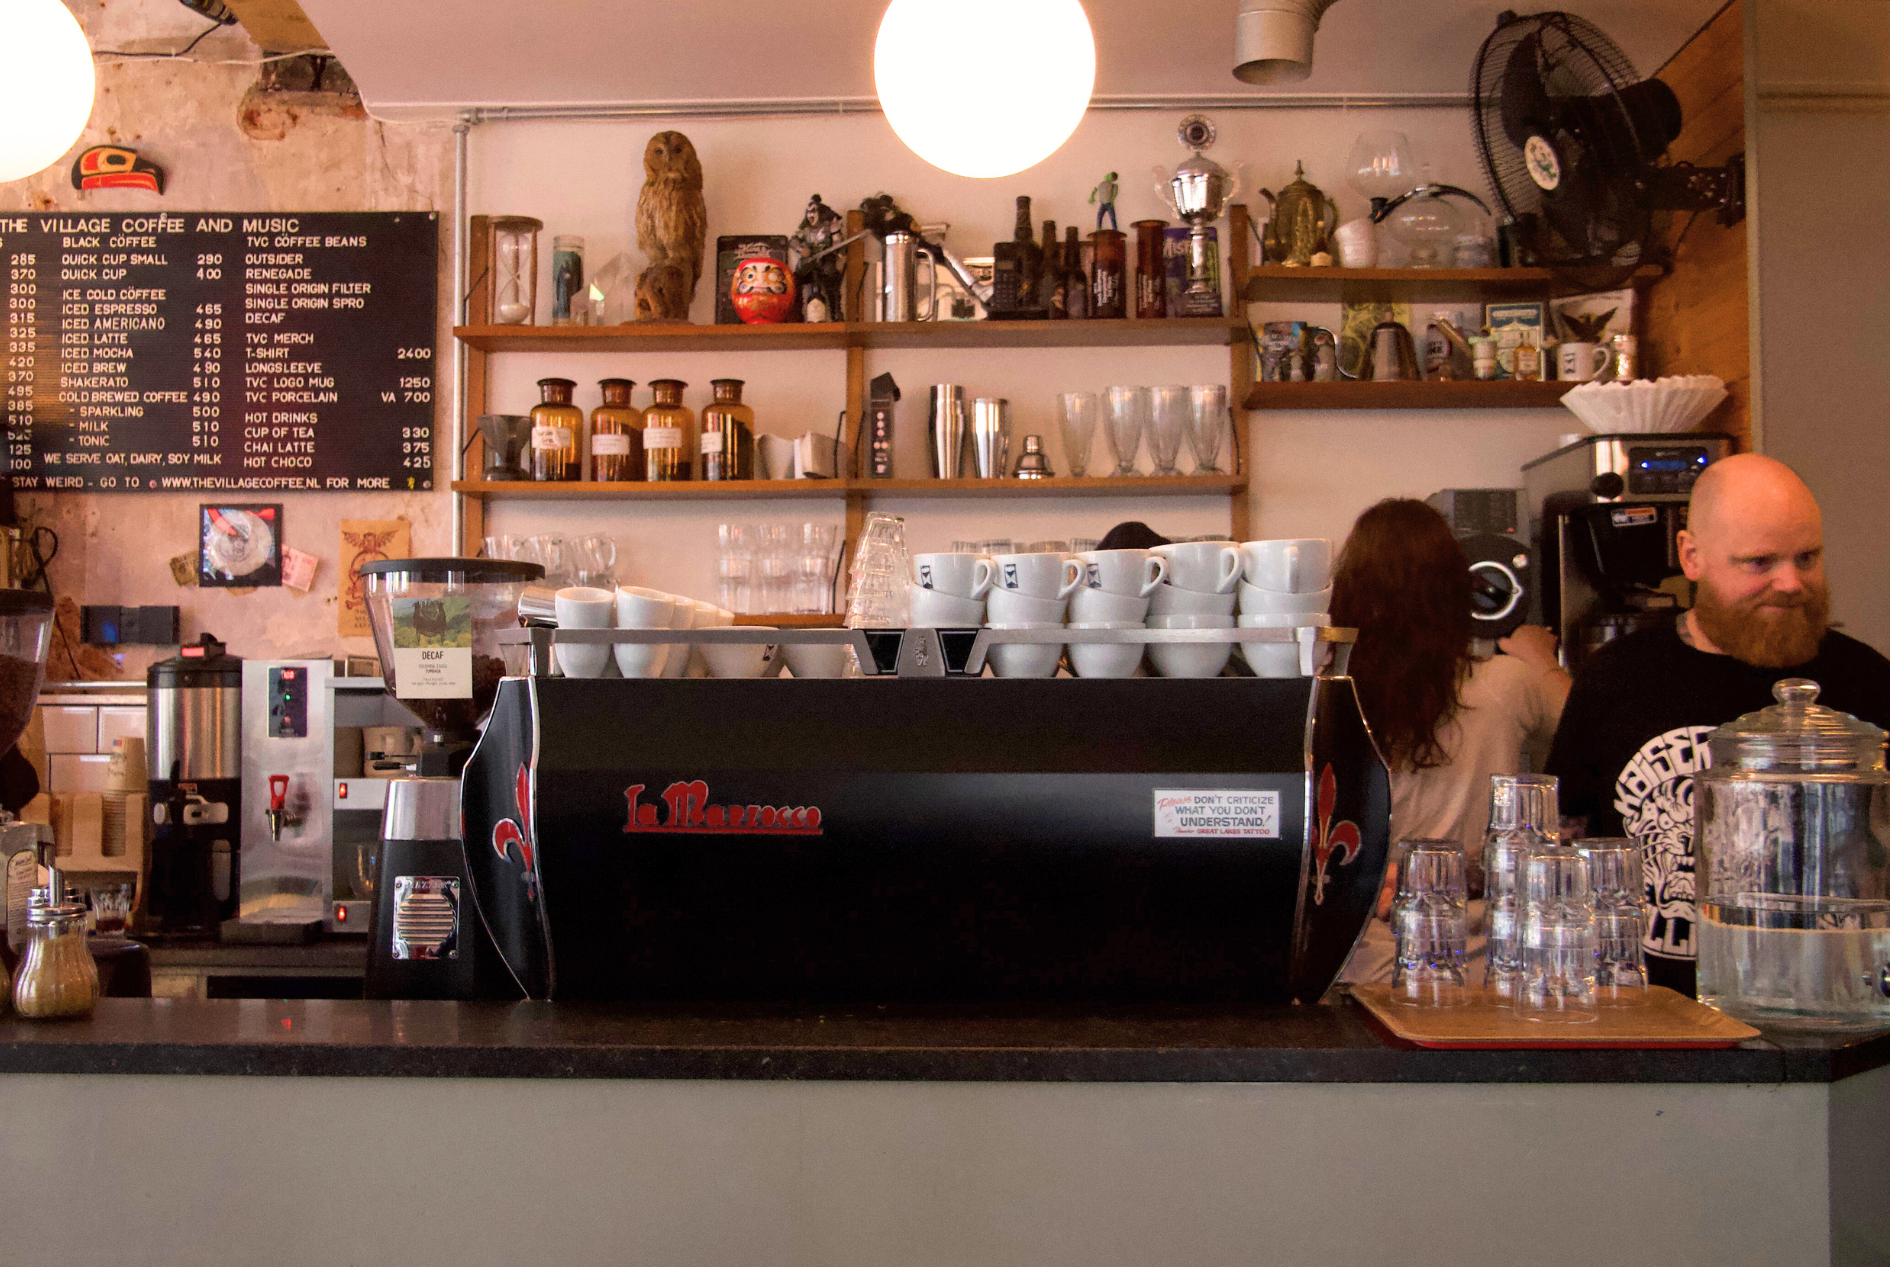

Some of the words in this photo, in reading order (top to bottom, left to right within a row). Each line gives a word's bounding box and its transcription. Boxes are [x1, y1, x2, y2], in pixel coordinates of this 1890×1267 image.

[0, 219, 27, 232] THE
[41, 219, 110, 233] VILLAGE
[121, 218, 184, 233] COFFEE
[196, 218, 232, 232] AND
[243, 219, 299, 233] MUSIC
[63, 237, 99, 247] BLACK
[248, 237, 268, 247] TVC
[325, 237, 366, 247] BEANS
[11, 253, 35, 265] 285
[62, 254, 97, 265] QUICK
[103, 254, 127, 265] CUP
[131, 254, 167, 265] SMALL
[246, 254, 303, 264] OUTSIDER
[11, 269, 35, 279] 370
[62, 269, 97, 280] QUICK
[103, 269, 126, 279] CUP
[197, 268, 221, 279] 400
[246, 269, 311, 279] RENEGADE
[11, 283, 36, 294] 300
[246, 283, 287, 294] SINGLE
[292, 283, 328, 294] ORIGIN
[333, 283, 371, 294] FILTER
[63, 289, 80, 300] ICE
[87, 289, 115, 300] COLD
[10, 298, 35, 309] 300
[246, 298, 288, 309] SINGLE
[292, 298, 328, 308] ORIGIN
[333, 298, 364, 308] SPRO
[63, 304, 89, 315] ICED
[95, 304, 157, 314] ESPRESSO
[196, 304, 221, 314] 465
[10, 313, 34, 324] 315
[62, 319, 89, 329] ICED
[94, 317, 165, 330] AMERICANO
[246, 313, 285, 323] DECAF
[10, 327, 35, 338] 325
[62, 333, 88, 344] ICED
[95, 333, 127, 344] LATTE
[195, 333, 221, 344] 465
[247, 333, 267, 344] TVC
[274, 333, 313, 344] MERCH
[10, 342, 35, 352] 335
[62, 348, 89, 358] ICED
[93, 348, 133, 358] MOCHA
[194, 348, 221, 358] 540
[246, 348, 289, 358] T-SHIRT
[398, 348, 431, 359] 2400
[9, 356, 34, 367] 420
[61, 362, 88, 373] ICED
[93, 362, 126, 373] BREW
[246, 362, 321, 373] LONGSLEEVE
[8, 371, 33, 381] 370
[61, 377, 128, 388] SHAKERATO
[194, 377, 220, 388] 510
[246, 377, 267, 387] TVC
[274, 377, 304, 388] LOGO
[309, 377, 334, 388] MUG
[400, 377, 430, 388] 1250
[59, 391, 90, 402] COLD
[91, 392, 139, 402] BREWED
[144, 392, 187, 402] COFFEE
[246, 392, 266, 402] TVC
[272, 392, 337, 402] PORCELAIN
[381, 392, 395, 402] VA
[405, 392, 430, 402] 700
[8, 400, 34, 411] 385
[80, 406, 143, 417] SPARKLING
[193, 406, 219, 417] 500
[9, 415, 33, 425] 510
[245, 413, 267, 423] HOT
[273, 412, 317, 423] DRINKS
[80, 421, 108, 431] MILK
[193, 421, 219, 432] 510
[245, 427, 269, 438] CUP
[272, 427, 288, 438] OF
[293, 427, 314, 438] TEA
[403, 427, 429, 438] 330
[79, 435, 109, 446] TONIC
[193, 435, 218, 447] 510
[10, 444, 31, 455] 125
[244, 442, 272, 452] CHAI
[278, 442, 314, 452] LATTE
[403, 442, 429, 453] 375
[11, 459, 31, 469] 100
[44, 453, 61, 463] WE
[66, 453, 101, 464] SERVE
[168, 453, 190, 464] SOY
[194, 454, 221, 464] MILK
[244, 457, 265, 467] HOT
[272, 457, 312, 467] CHOCO
[404, 456, 431, 468] 425
[12, 477, 38, 488] STAY
[46, 477, 83, 488] WEIRD
[100, 477, 116, 487] GO
[125, 477, 139, 487] TO
[327, 478, 349, 488] FOR
[357, 478, 390, 488] MORE
[422, 650, 444, 660] DECAF
[1194, 794, 1222, 804] DON'T
[1175, 806, 1205, 815] WHAT
[1208, 806, 1231, 815] YOU
[1234, 805, 1265, 815] DON'T
